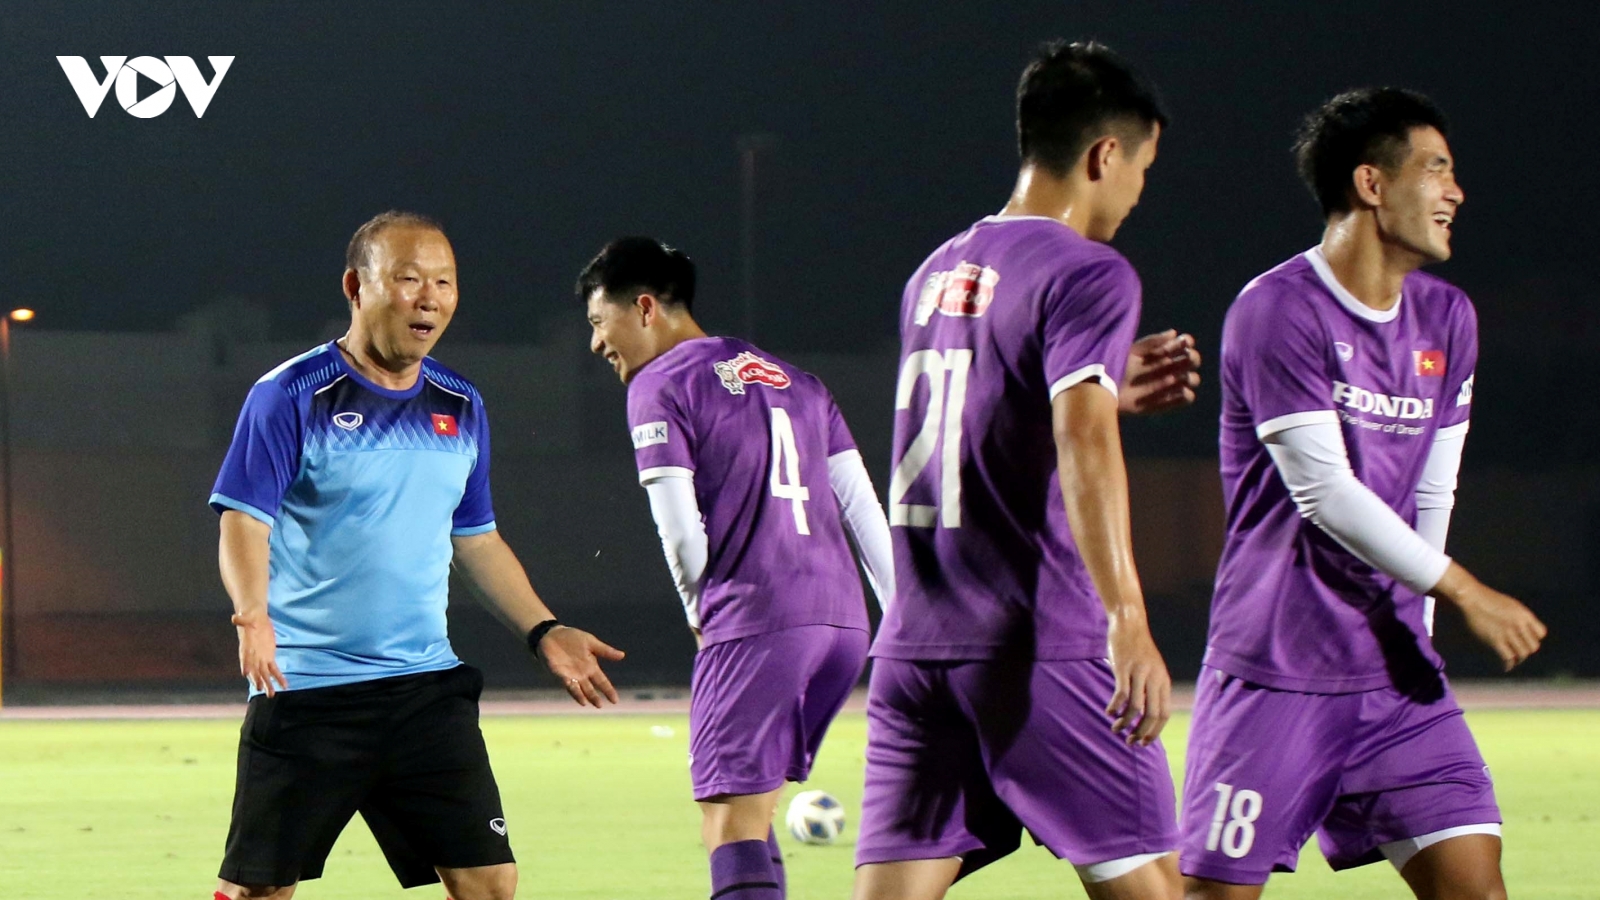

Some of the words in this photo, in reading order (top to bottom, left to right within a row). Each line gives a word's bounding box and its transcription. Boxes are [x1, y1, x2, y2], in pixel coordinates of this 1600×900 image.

[888, 348, 974, 529] 21
[1332, 380, 1434, 419] HONDA
[769, 407, 810, 536] 4
[1205, 782, 1264, 859] 18
